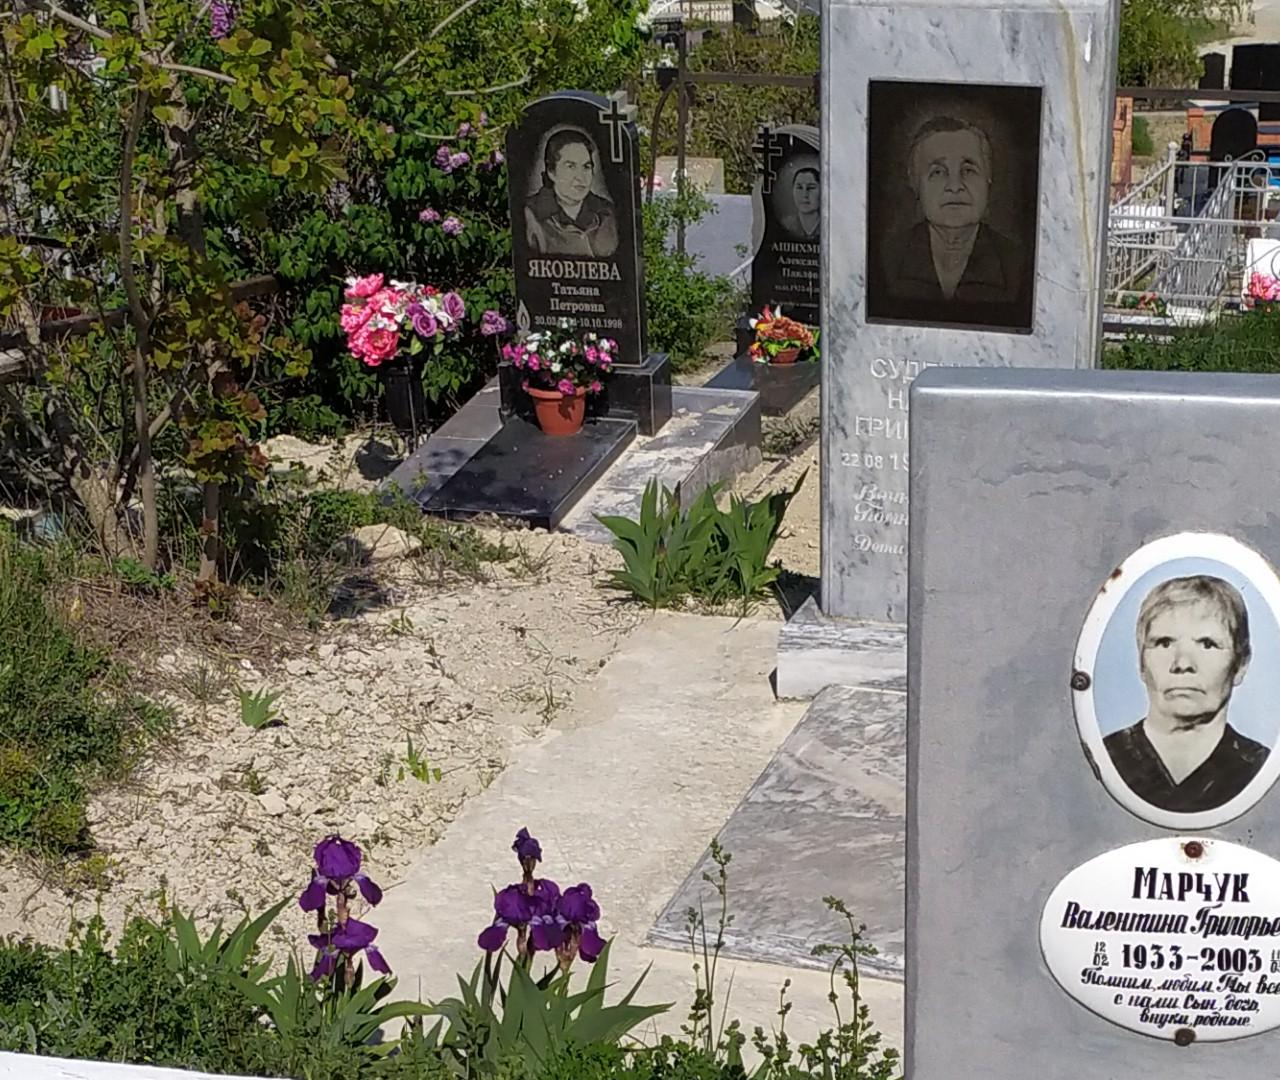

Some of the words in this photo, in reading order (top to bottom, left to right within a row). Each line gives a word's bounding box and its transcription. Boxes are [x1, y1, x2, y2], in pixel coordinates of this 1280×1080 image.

[528, 259, 622, 281] ЯКОВЛЕВА
[777, 255, 820, 267] Алексан
[551, 282, 601, 297] Татьяна
[549, 298, 606, 314] Петровна
[1060, 900, 1189, 934] Валентина
[1216, 972, 1252, 994] Ты
